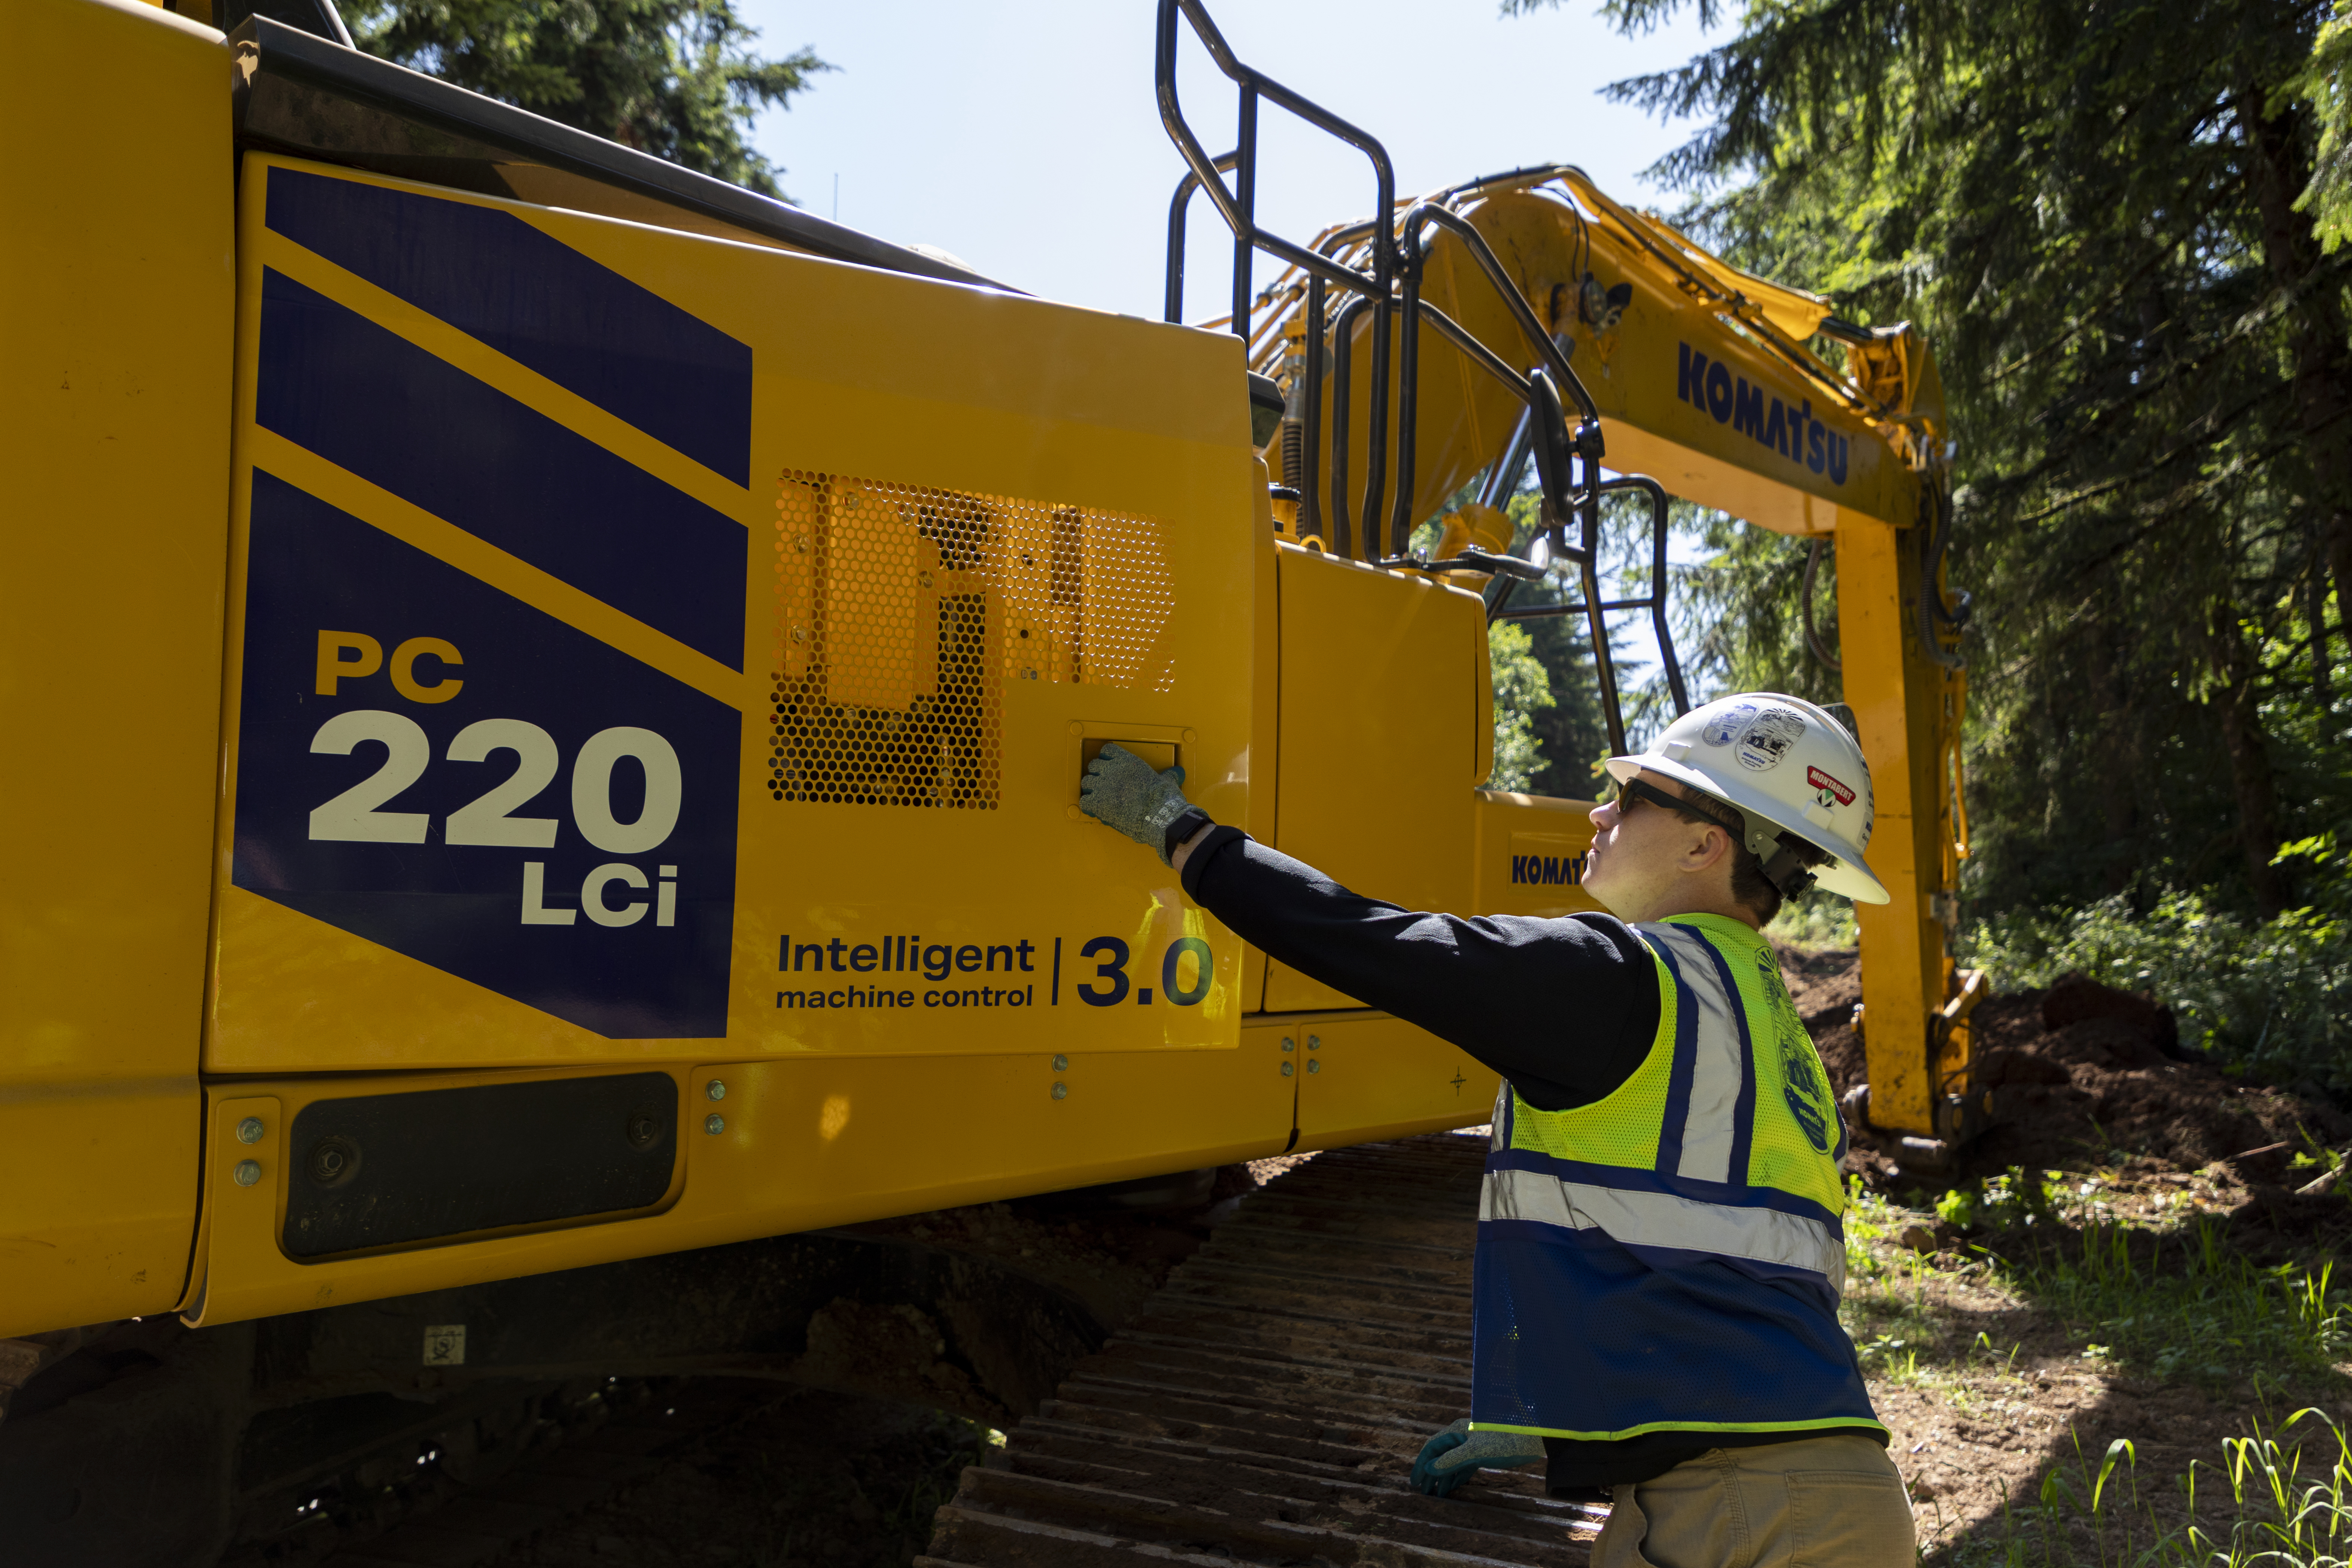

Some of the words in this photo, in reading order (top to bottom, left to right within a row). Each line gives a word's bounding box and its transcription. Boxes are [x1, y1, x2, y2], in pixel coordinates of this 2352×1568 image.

[1678, 340, 1848, 486] KOMATSU
[316, 629, 464, 704] PC
[1742, 752, 1765, 764] KOMATSU
[309, 710, 682, 854] 220
[1810, 770, 1853, 801] MONTABERT
[1512, 850, 1588, 885] KOMAT
[522, 862, 677, 927] LCi
[778, 935, 1035, 981] Intelligent
[1077, 936, 1213, 1006] 3.0
[777, 985, 915, 1008] machine
[923, 984, 1033, 1007] control
[1798, 1107, 1823, 1129] KOMATS
